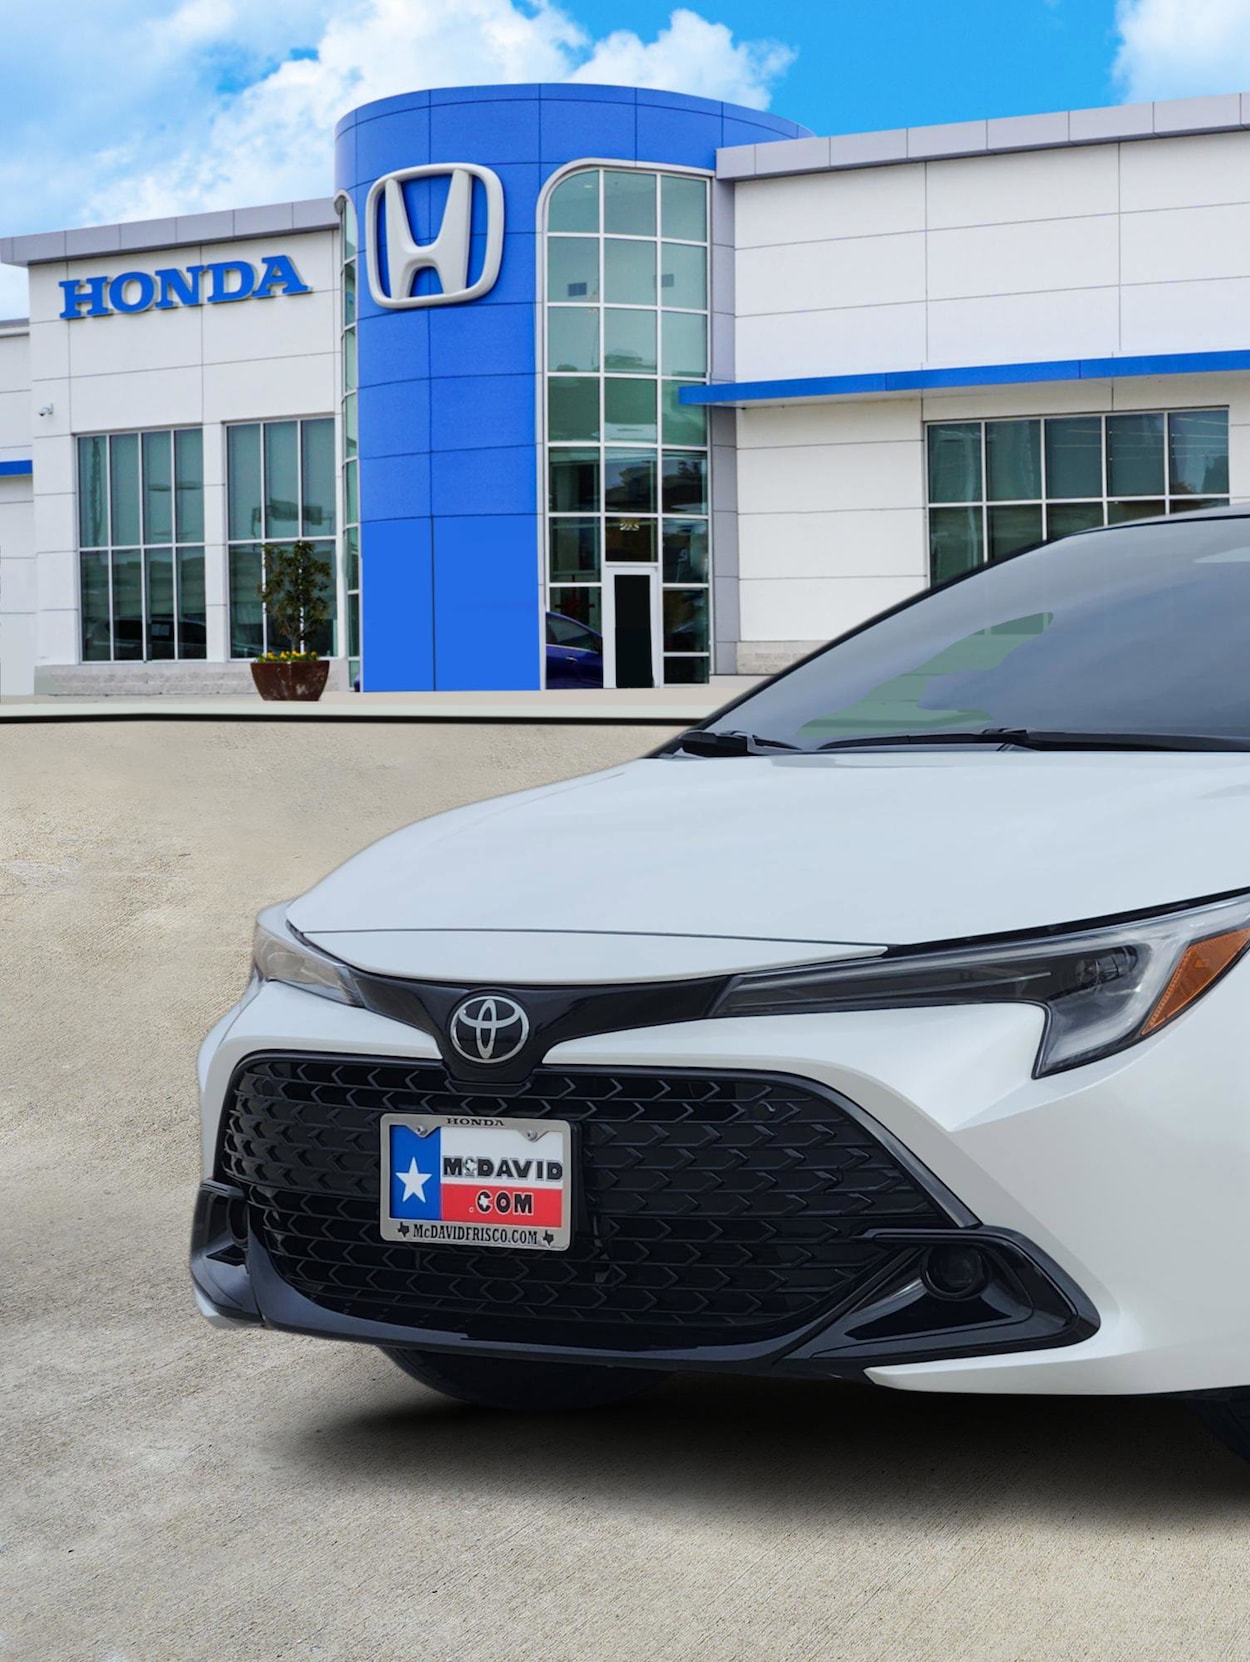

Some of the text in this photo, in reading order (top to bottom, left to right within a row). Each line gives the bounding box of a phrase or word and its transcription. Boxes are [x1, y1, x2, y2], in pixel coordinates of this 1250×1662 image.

[59, 255, 311, 319] HONDA
[446, 1117, 505, 1127] HONDA
[413, 1224, 538, 1245] McDAVIDFRISCO.COM
